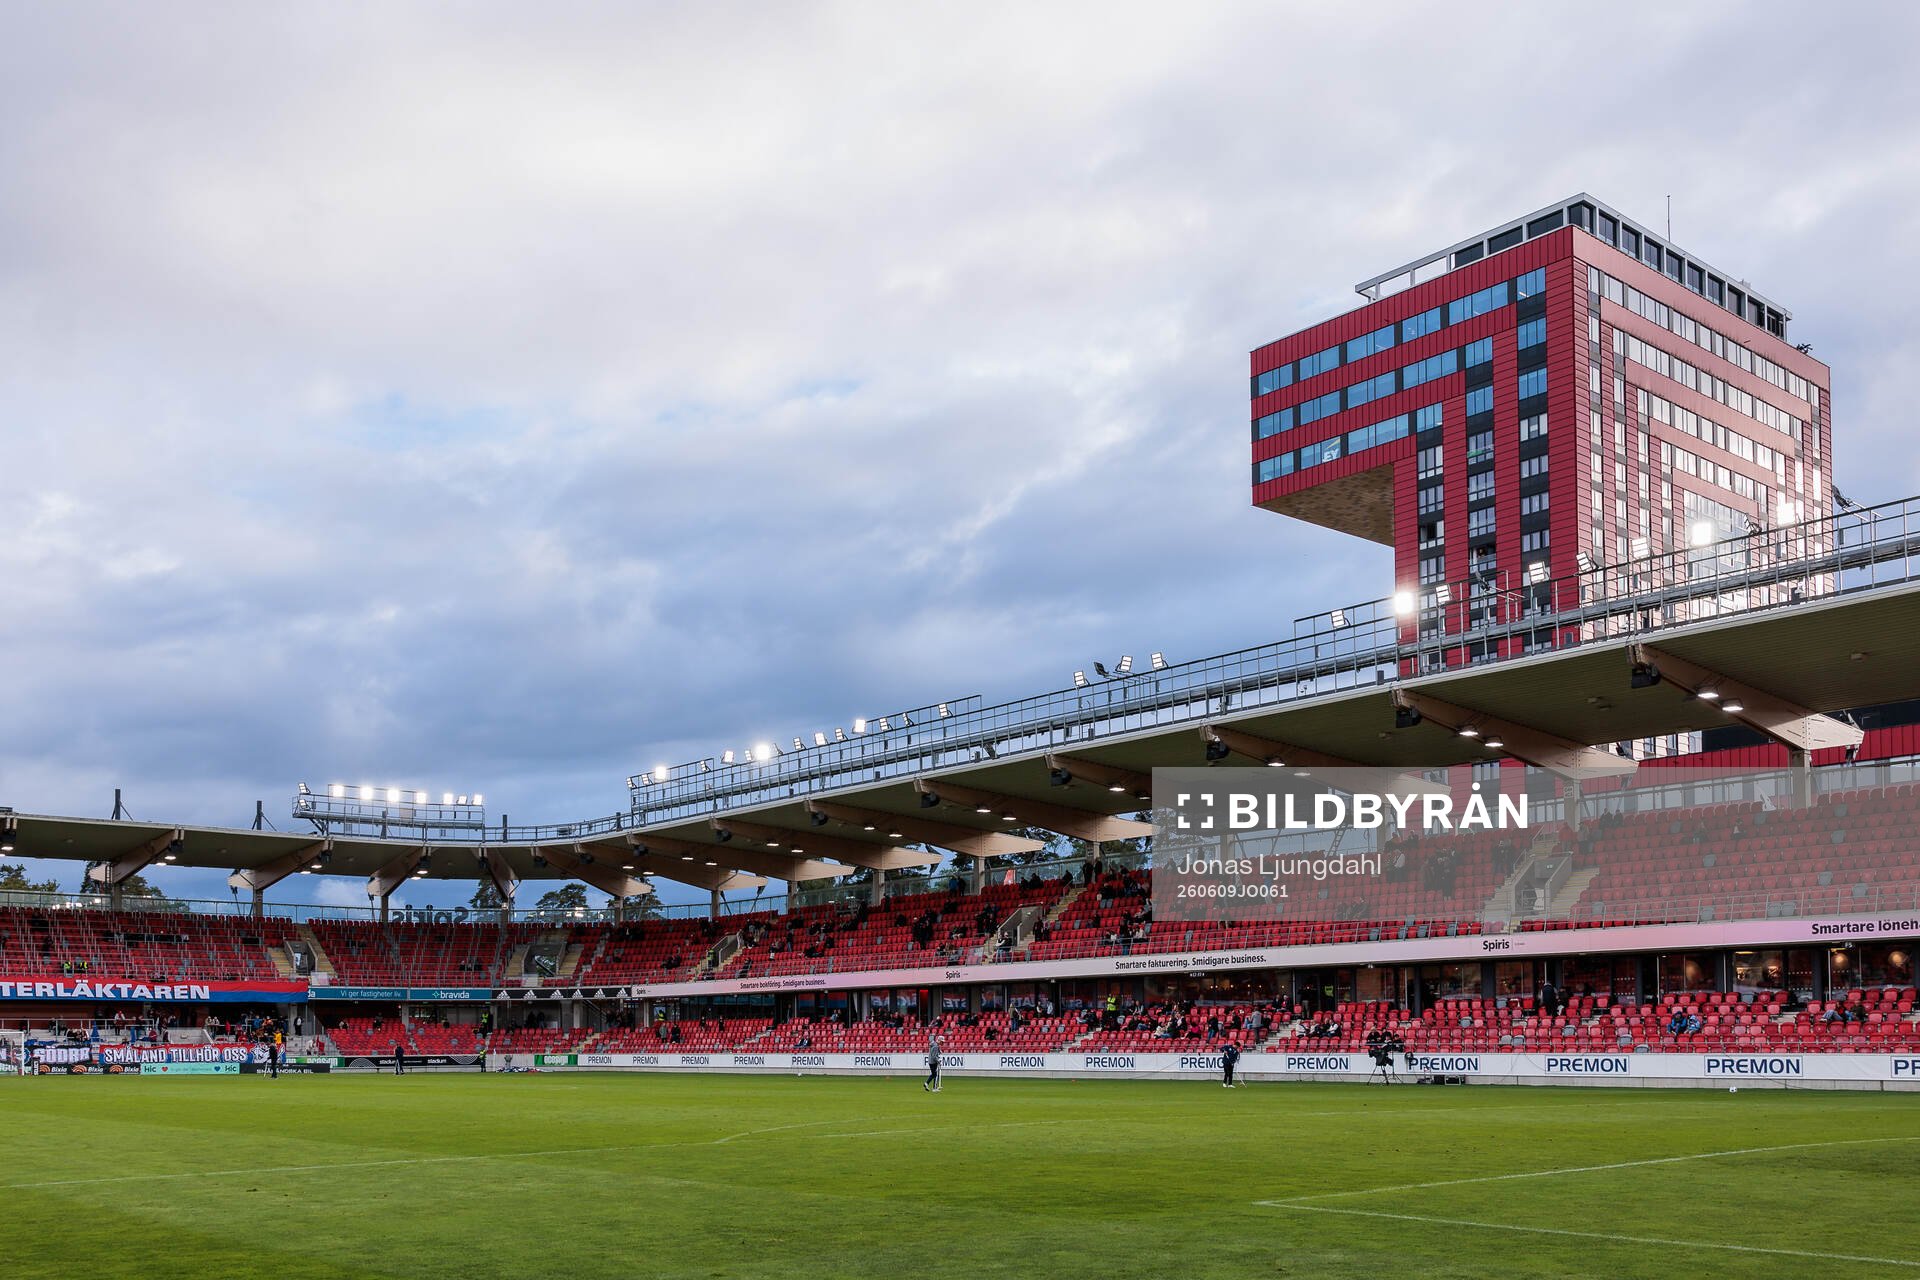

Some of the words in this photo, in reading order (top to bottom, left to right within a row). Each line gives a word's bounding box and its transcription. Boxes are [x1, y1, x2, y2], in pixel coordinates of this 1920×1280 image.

[1811, 922, 1875, 935] Smartare
[1878, 918, 1920, 932] löneh
[1482, 939, 1510, 952] Spiris
[1115, 960, 1147, 970] Smartare
[1148, 957, 1190, 968] fakturering.
[1191, 955, 1230, 967] Smidigare
[1231, 953, 1267, 964] business.
[945, 970, 961, 980] Spiris
[0, 979, 211, 999] TERLÄKTAREN
[440, 990, 470, 999] bravida
[104, 1045, 167, 1062] SMÅLAND
[169, 1045, 220, 1062] TILLHÖR
[222, 1047, 248, 1061] OSS
[588, 1055, 612, 1064] PREMON
[632, 1055, 659, 1065] PREMON
[681, 1056, 709, 1065] PREMON
[734, 1056, 765, 1066] PREMON
[792, 1056, 825, 1066] PREMON
[855, 1056, 891, 1067] PREMON
[924, 1056, 964, 1067] PMON
[1000, 1056, 1044, 1067] PREMON
[1086, 1056, 1134, 1068] PREMON
[1180, 1057, 1224, 1069] PREMO
[1288, 1057, 1349, 1070] PREMON
[1408, 1057, 1478, 1071] PREMON
[1547, 1058, 1628, 1073] PREMON
[1707, 1058, 1800, 1074] PREMON
